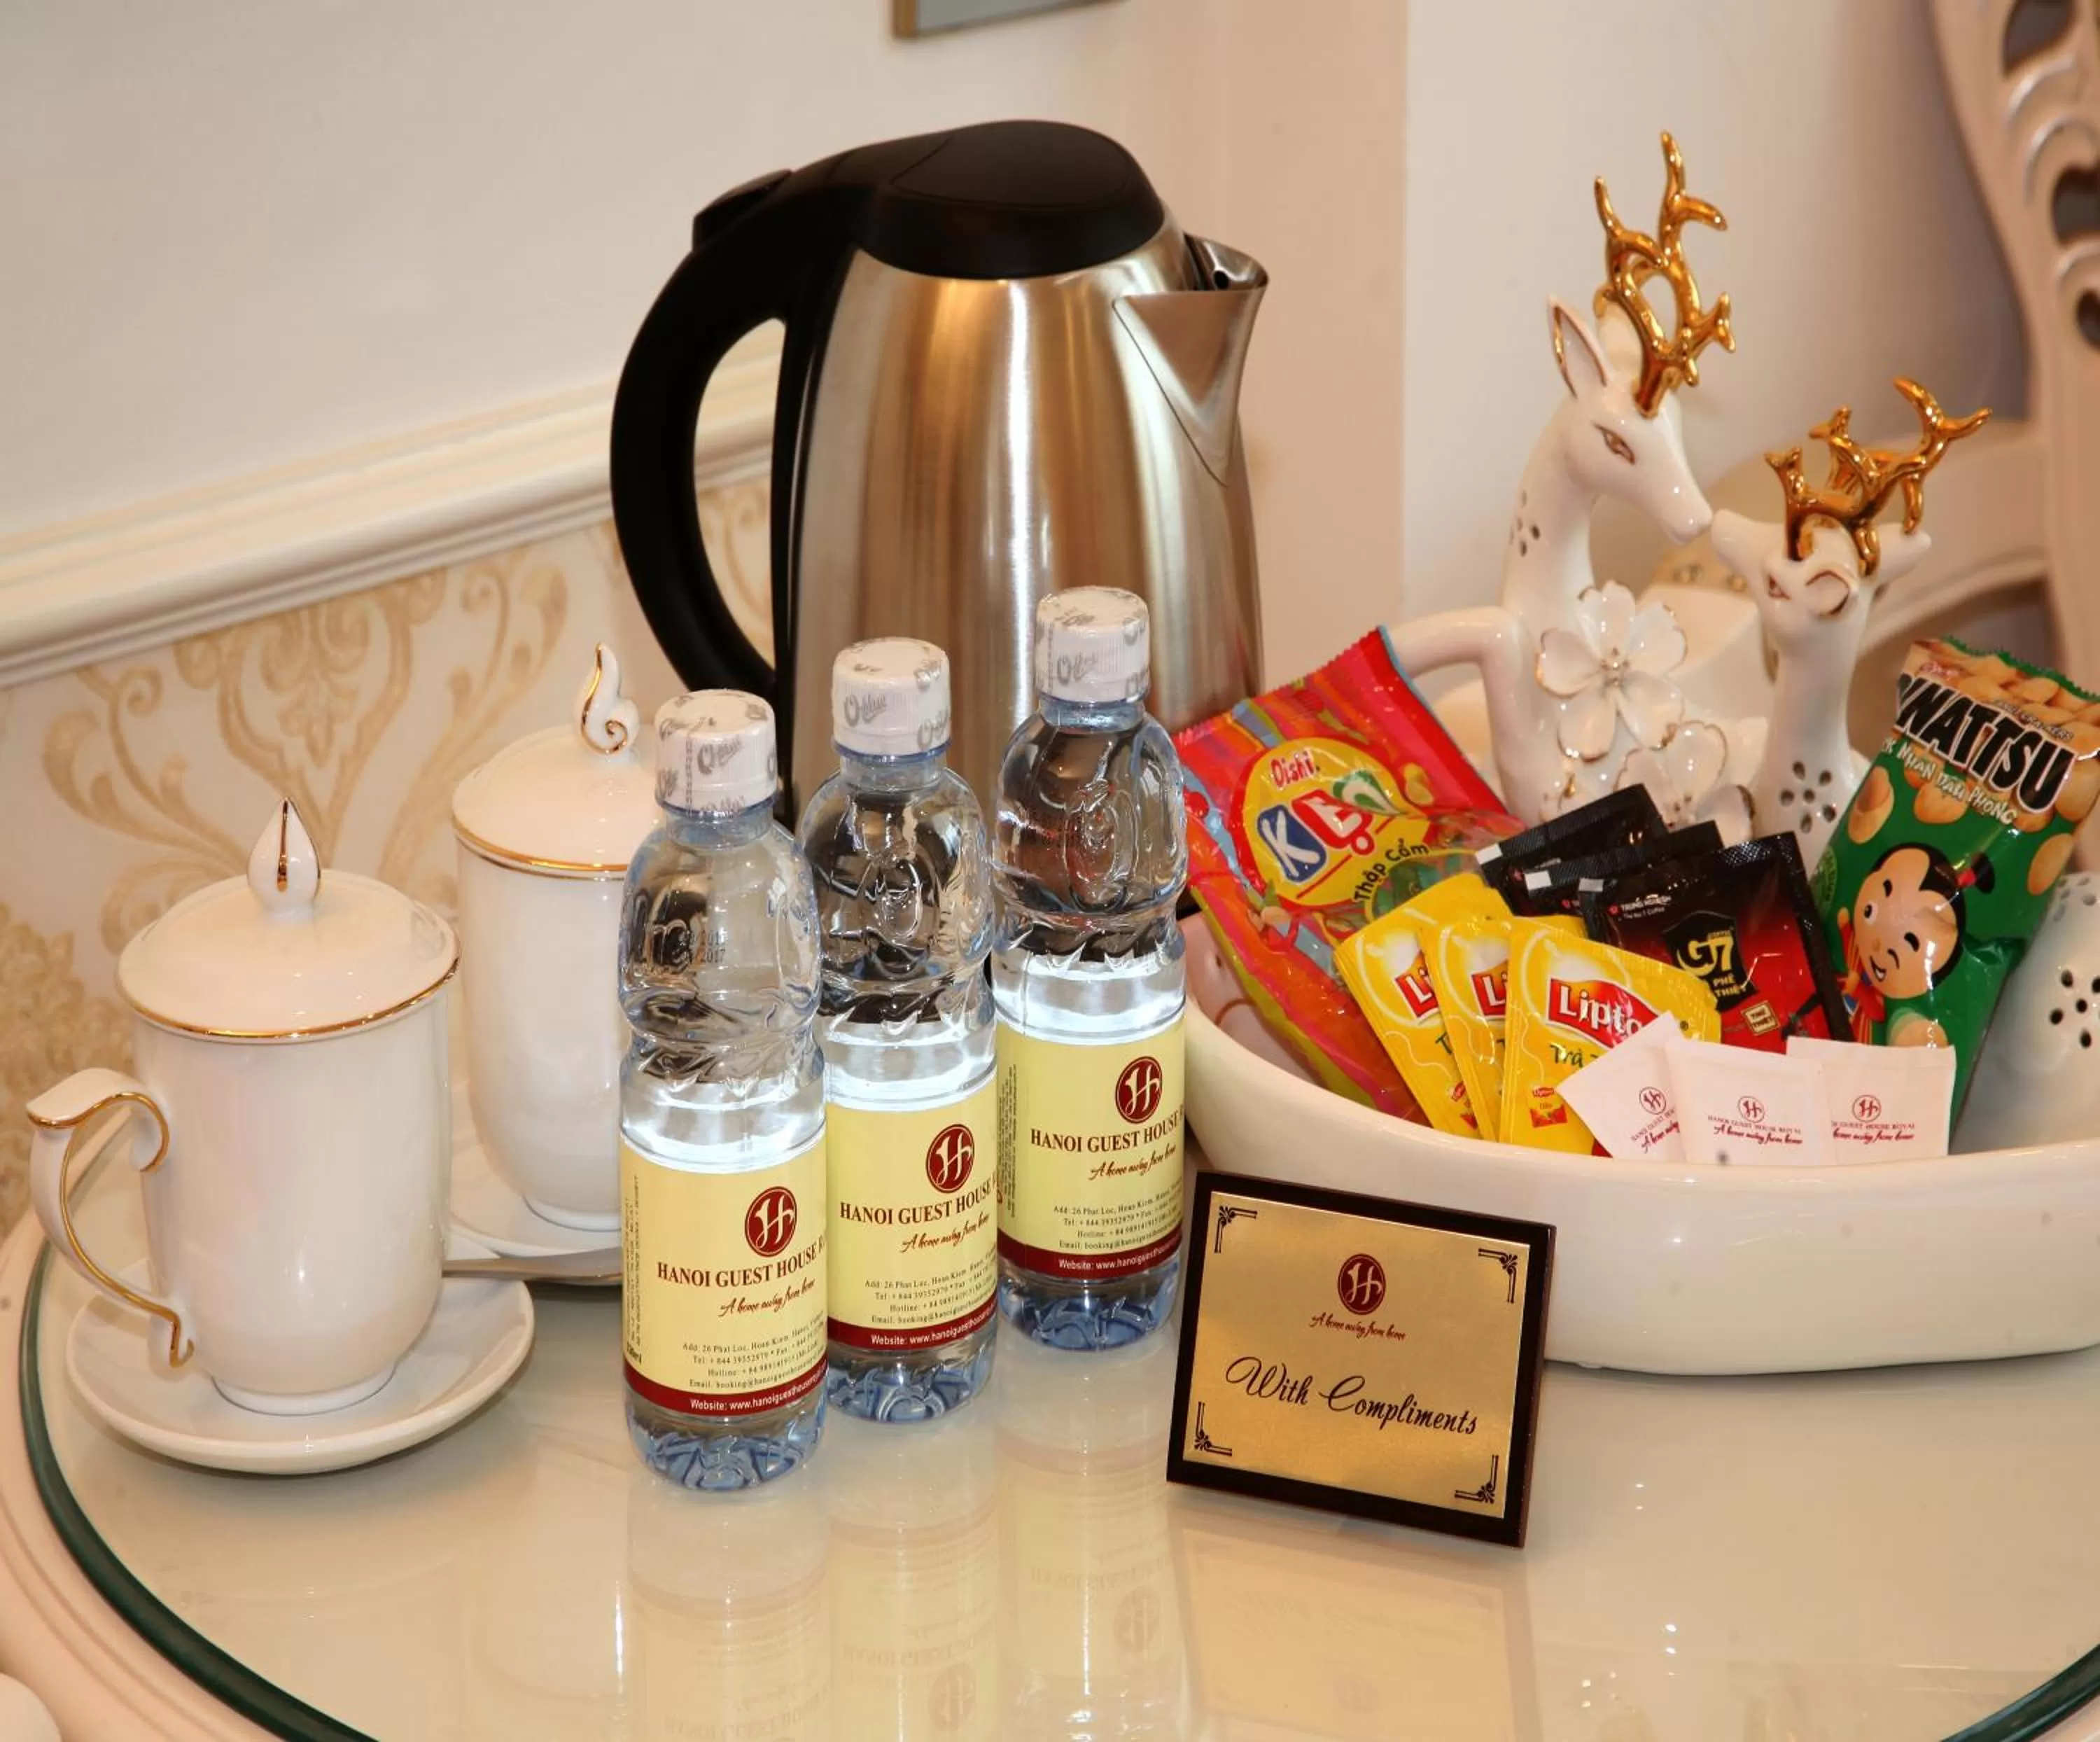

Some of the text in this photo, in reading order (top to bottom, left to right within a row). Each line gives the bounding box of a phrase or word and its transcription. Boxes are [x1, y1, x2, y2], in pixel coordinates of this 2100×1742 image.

[1677, 932, 1734, 976] G7
[1559, 985, 1644, 1039] Lipto
[1030, 1110, 1178, 1152] HANOI GUEST HOUSE
[840, 1201, 893, 1225] HANOI
[898, 1199, 953, 1225] GUEST
[955, 1178, 992, 1214] HOUSE
[657, 1261, 710, 1288] HANOI
[715, 1264, 774, 1288] GUEST
[776, 1243, 817, 1278] HOUSE
[1058, 1258, 1094, 1271] Website:
[872, 1335, 907, 1346] Website:
[690, 1399, 727, 1411] Website:
[1225, 1356, 1478, 1435] With Compliments
